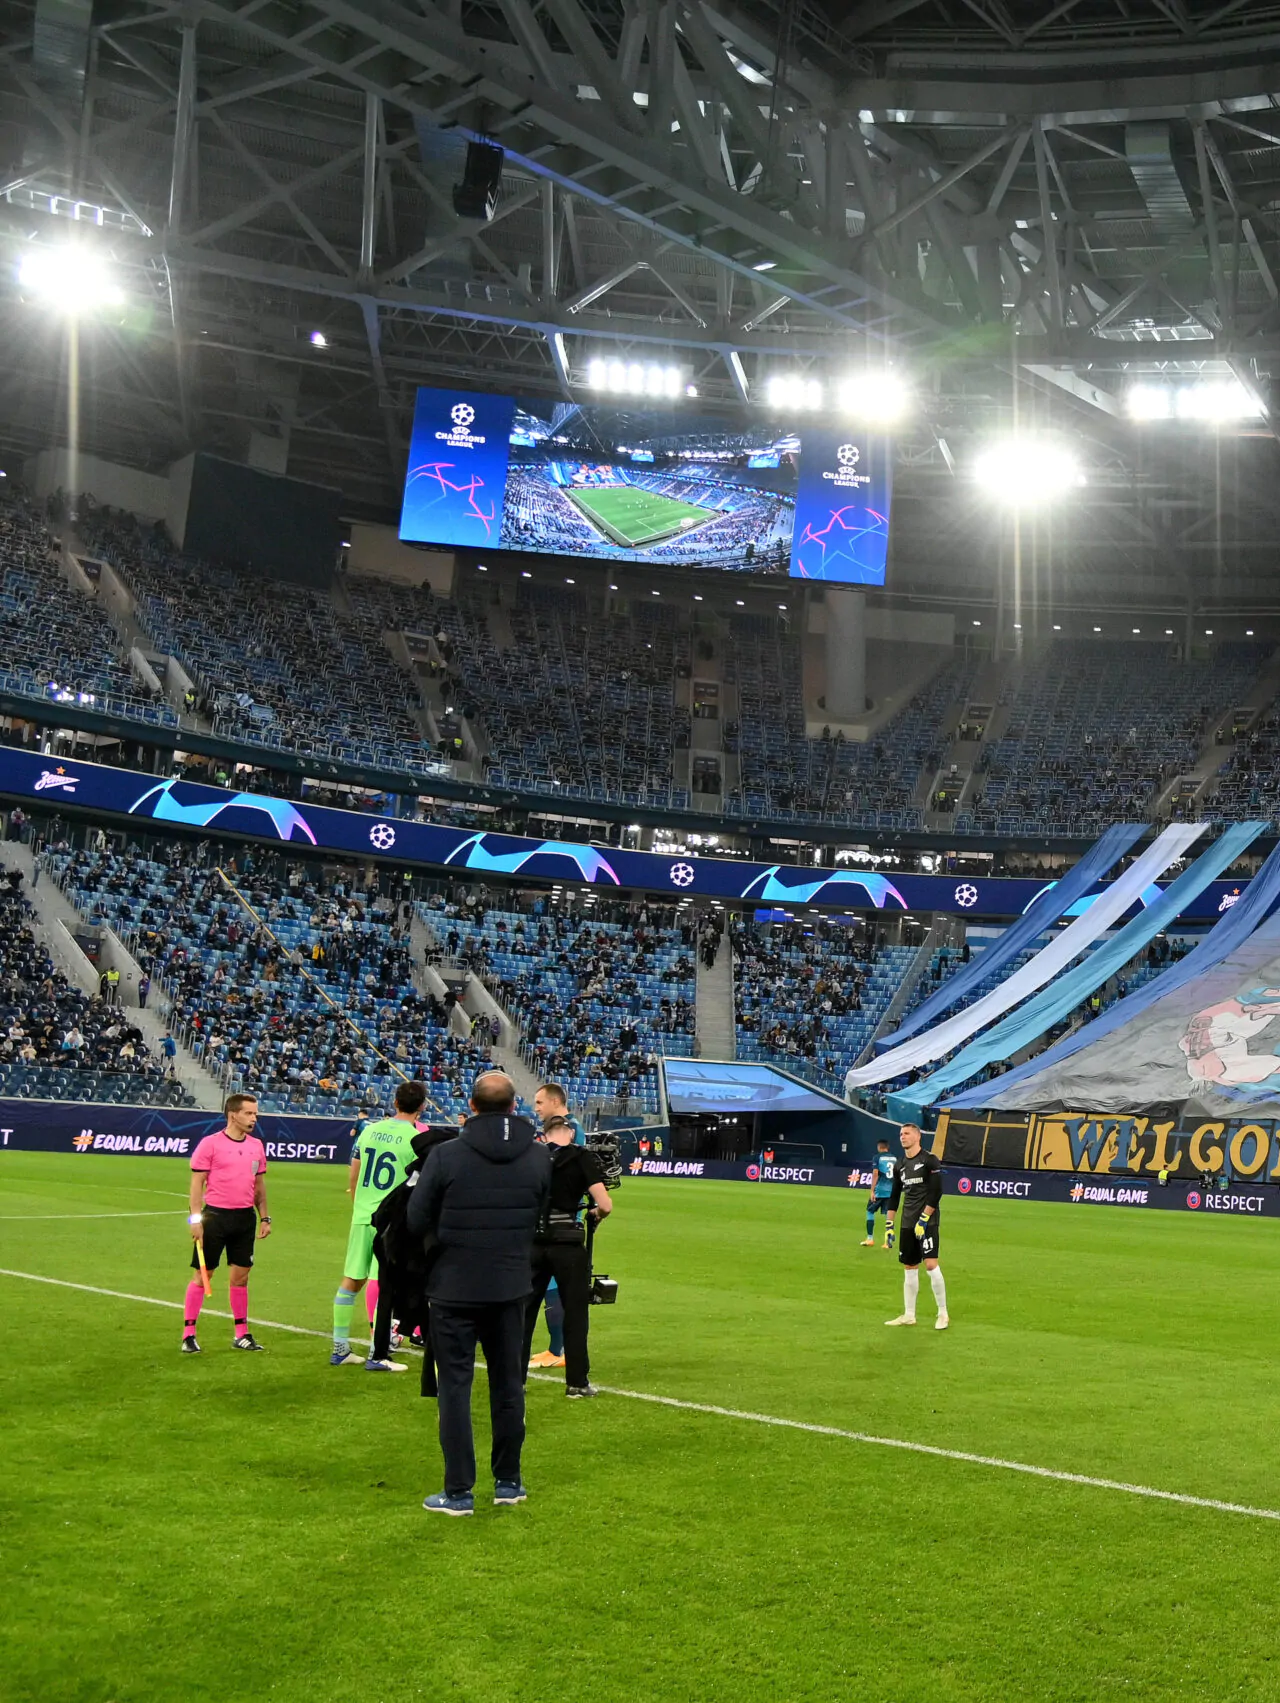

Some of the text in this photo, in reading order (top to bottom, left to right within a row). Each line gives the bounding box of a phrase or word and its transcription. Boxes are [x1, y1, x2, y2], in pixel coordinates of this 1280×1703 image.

[435, 431, 486, 444] CHAMPIONS
[447, 440, 474, 449] LEAGUE
[822, 471, 871, 483] CHAMPIONS
[833, 480, 860, 488] LEAGUE
[73, 1129, 190, 1153] #EQUAL GAME
[266, 1142, 337, 1160] RESPECT
[362, 1147, 396, 1191] 16
[629, 1157, 704, 1176] #EQUAL GAME
[764, 1166, 815, 1182] RESPECT
[975, 1179, 1032, 1196] RESPECT
[1070, 1182, 1148, 1204] #EQUAL GAME
[1205, 1194, 1265, 1212] RESPECT
[922, 1237, 934, 1250] 41
